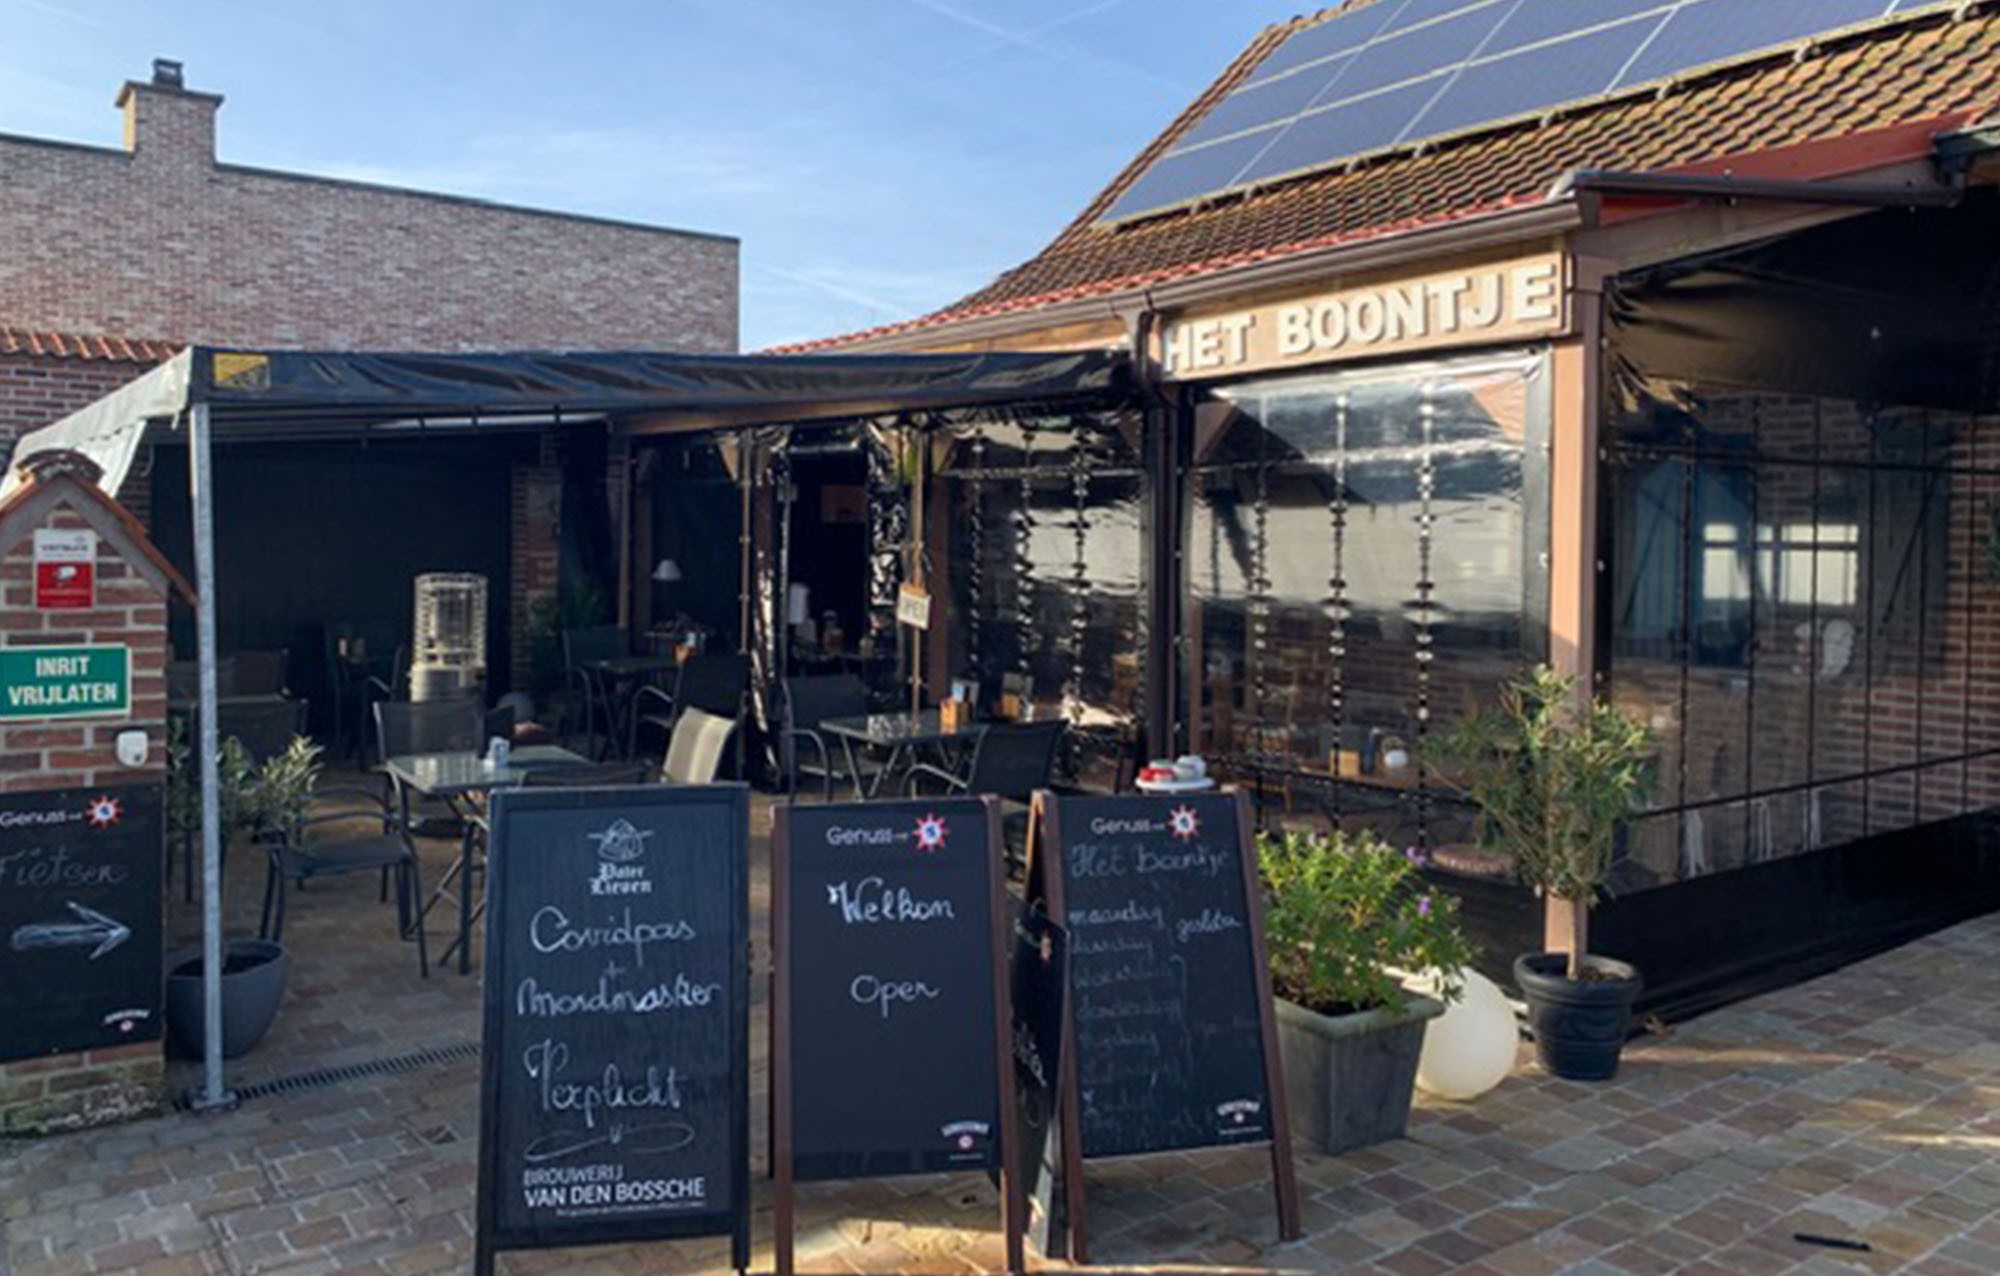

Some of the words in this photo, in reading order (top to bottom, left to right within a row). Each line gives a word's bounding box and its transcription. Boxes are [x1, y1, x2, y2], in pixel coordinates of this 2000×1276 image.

[1164, 313, 1254, 373] HET
[1277, 262, 1557, 356] BOONTJE
[36, 656, 90, 677] INRIT
[8, 682, 118, 706] VRIJLATEN
[530, 906, 696, 967] Covidpas
[850, 974, 941, 1019] Open
[524, 1165, 623, 1187] BROUWERIJ
[524, 1188, 567, 1208] VAN
[571, 1184, 612, 1205] DEN
[615, 1176, 706, 1202] BOSSCHE
